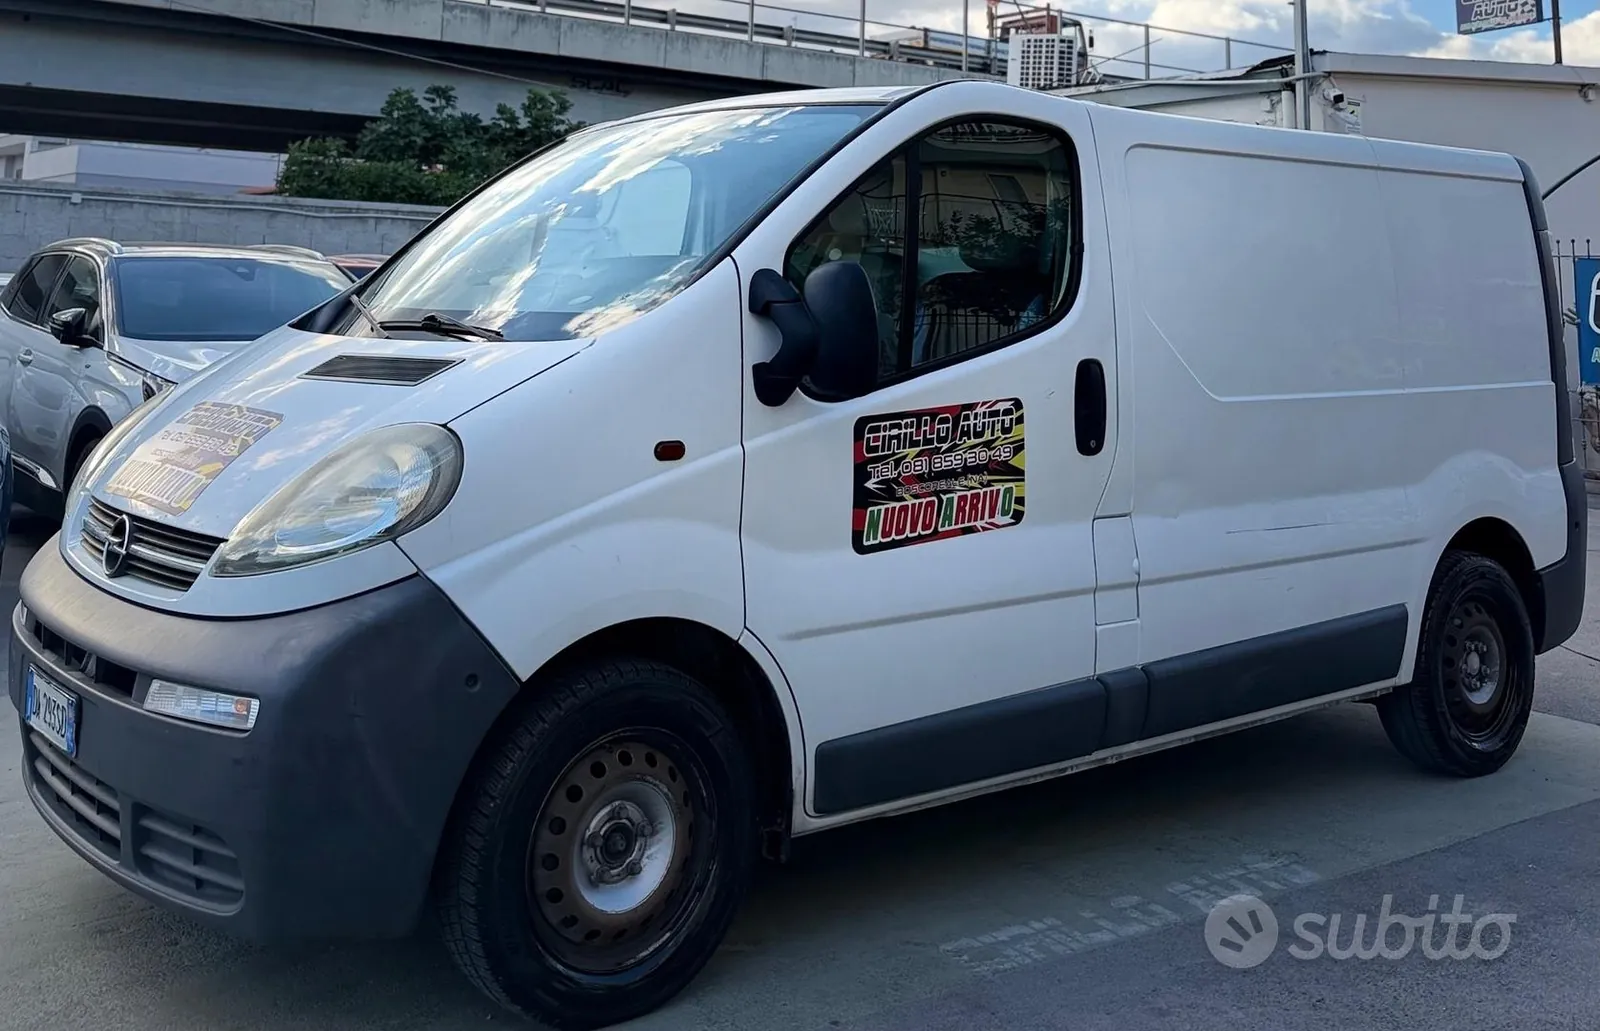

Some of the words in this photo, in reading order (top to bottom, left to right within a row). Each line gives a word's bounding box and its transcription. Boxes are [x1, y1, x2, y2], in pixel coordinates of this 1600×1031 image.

[1471, 0, 1521, 20] AUTO
[864, 414, 952, 457] CIRILLO
[956, 406, 1015, 444] AUTO
[867, 462, 897, 479] Tel.
[900, 456, 929, 476] 081
[932, 450, 965, 471] 859
[966, 448, 988, 466] 30
[991, 445, 1013, 462] 49
[863, 497, 937, 545] NUOVO
[938, 485, 1015, 531] ARRIVO
